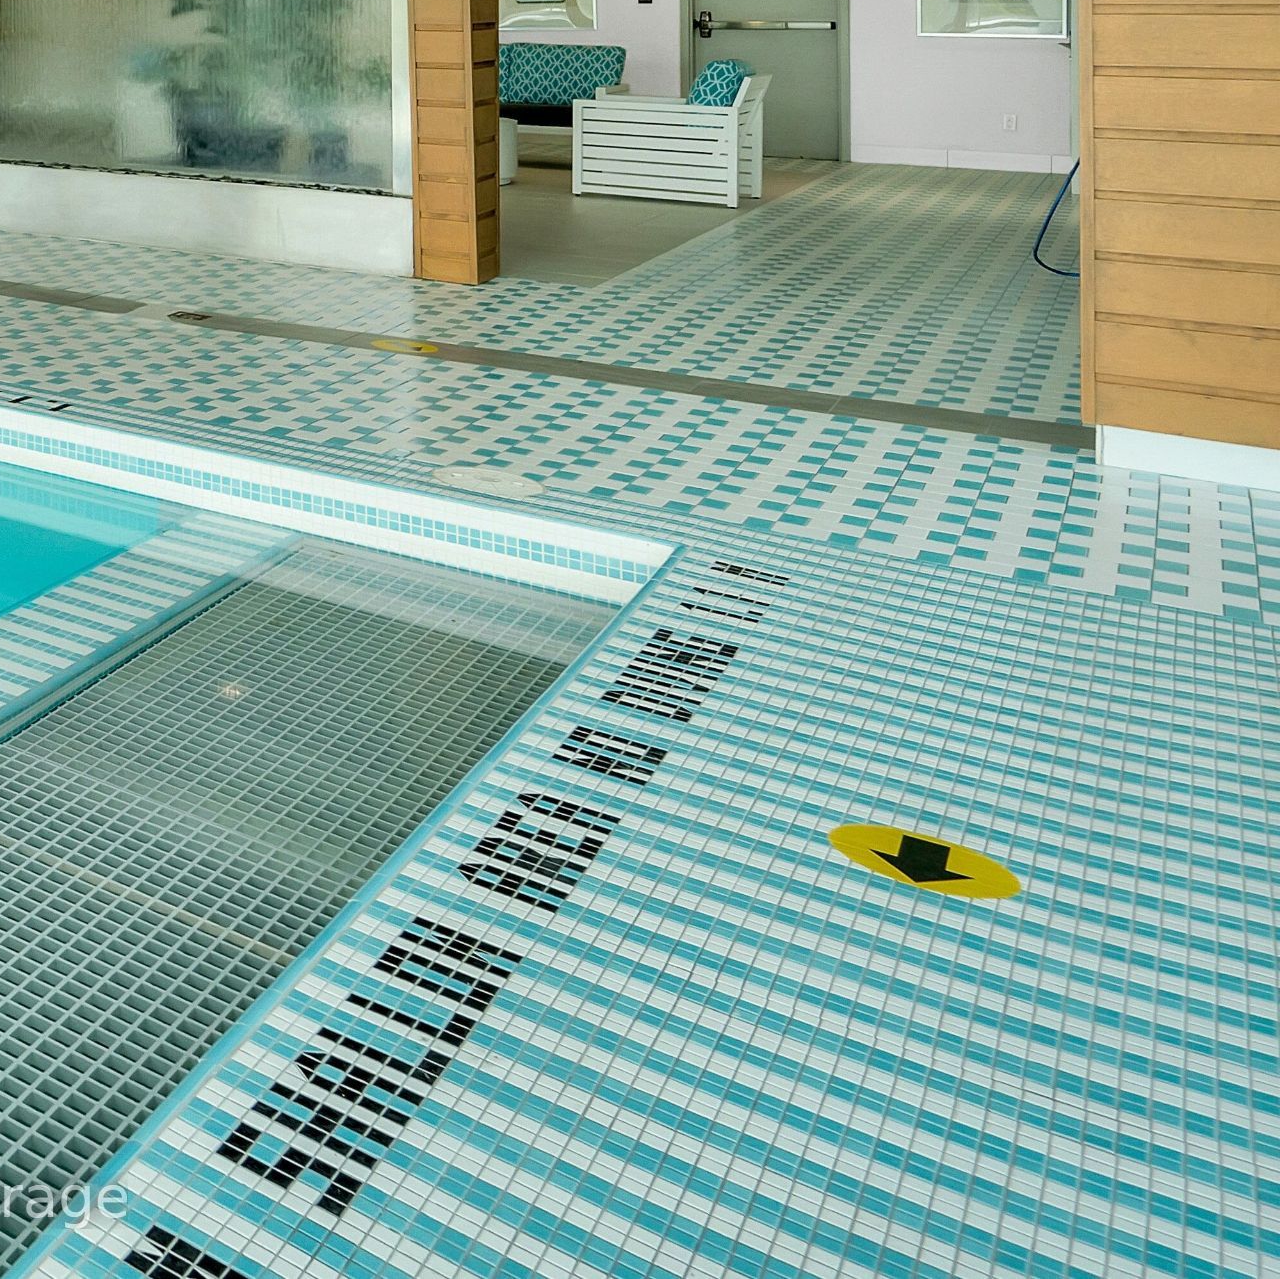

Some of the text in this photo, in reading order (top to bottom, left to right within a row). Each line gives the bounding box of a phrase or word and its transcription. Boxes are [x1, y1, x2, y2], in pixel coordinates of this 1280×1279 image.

[600, 628, 740, 723] DIVING
[552, 725, 669, 786] NO
[457, 792, 621, 914] AREA
[217, 915, 523, 1219] SHALLOW
